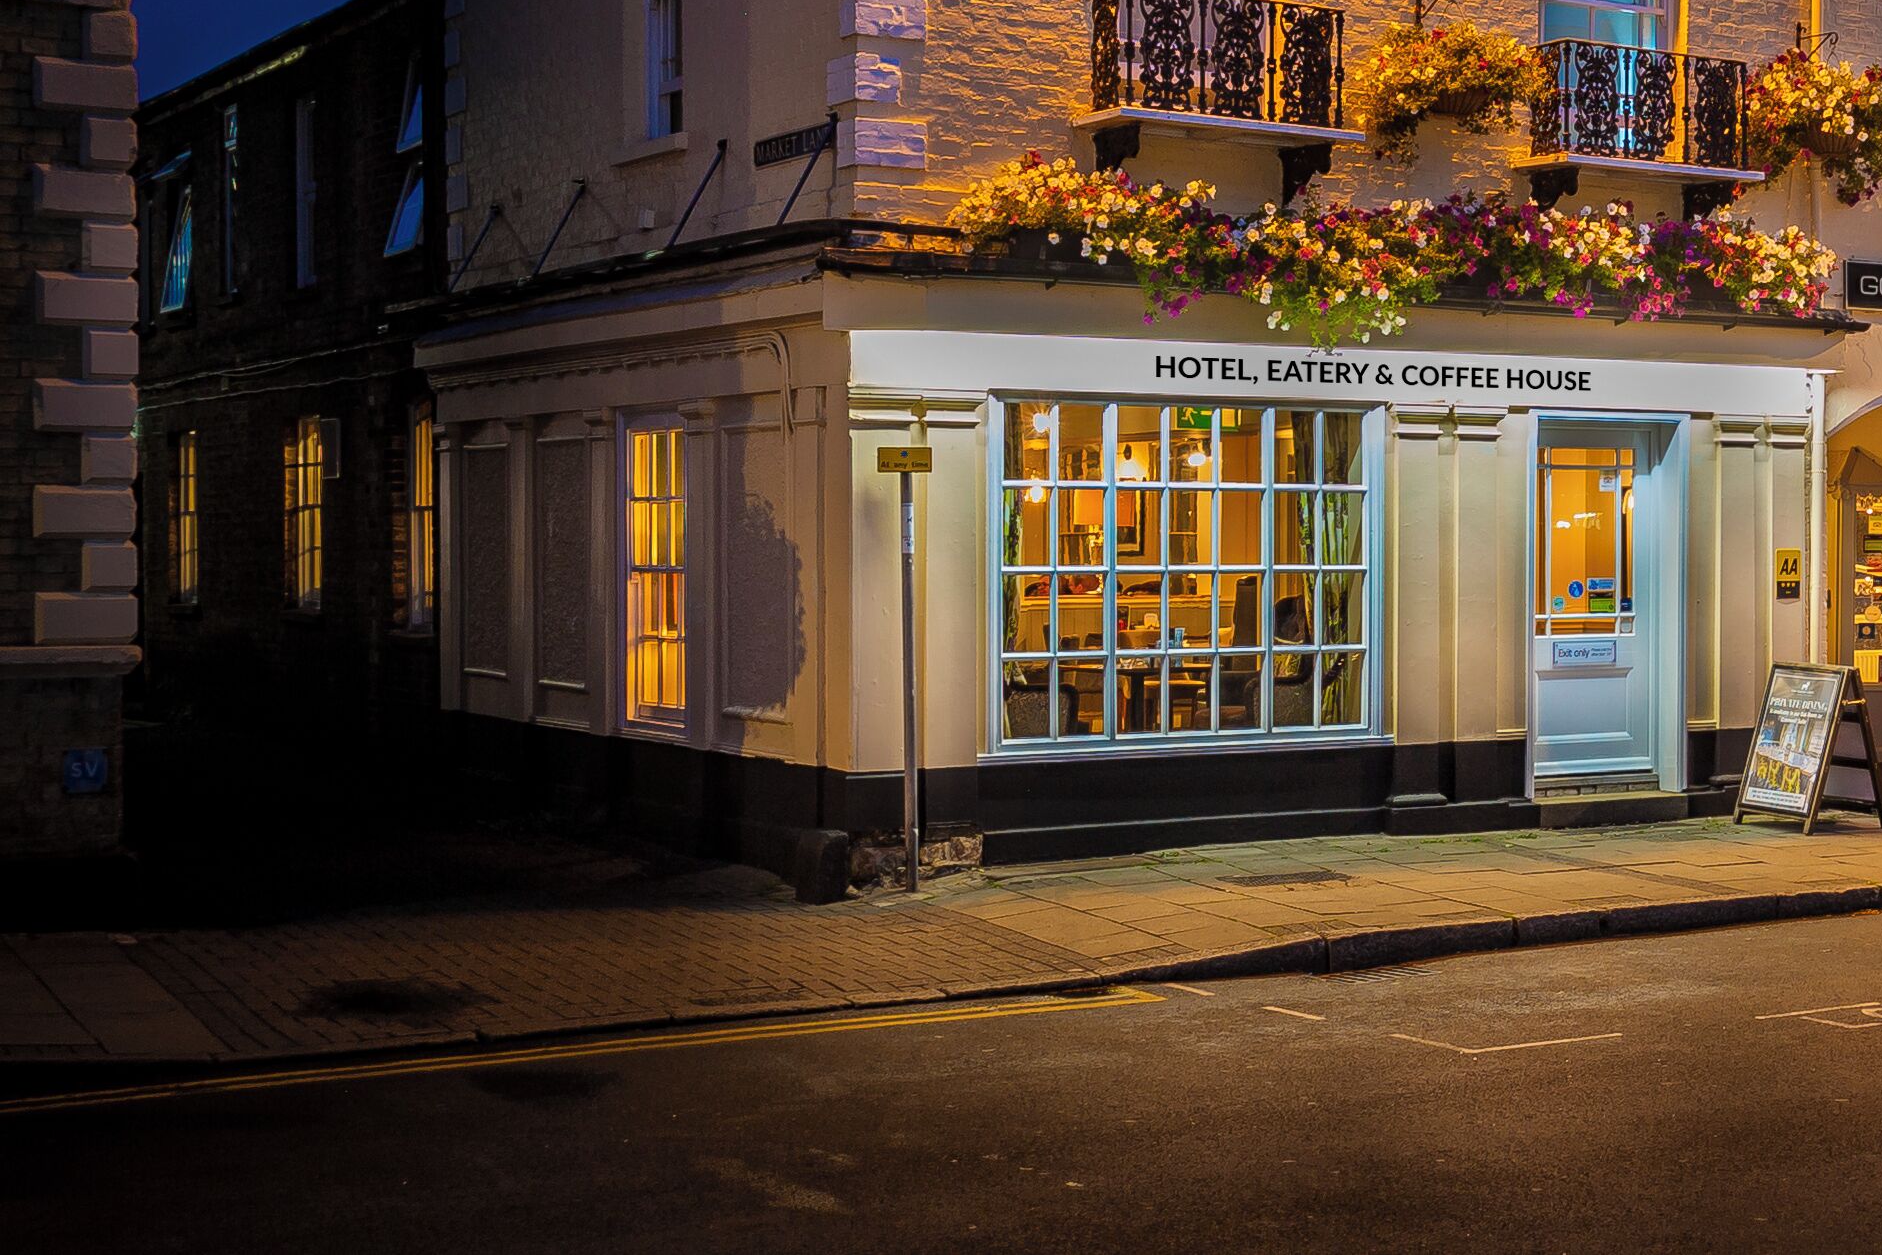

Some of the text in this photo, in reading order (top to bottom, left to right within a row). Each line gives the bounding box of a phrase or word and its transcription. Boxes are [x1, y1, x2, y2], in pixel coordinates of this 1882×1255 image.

[756, 136, 797, 163] MARKET
[1154, 355, 1592, 391] HOTEL, EATERY & COFFEE HOUSE
[1779, 557, 1798, 575] AA
[1558, 648, 1573, 658] Exit
[1573, 648, 1590, 658] only
[71, 761, 98, 778] SV
